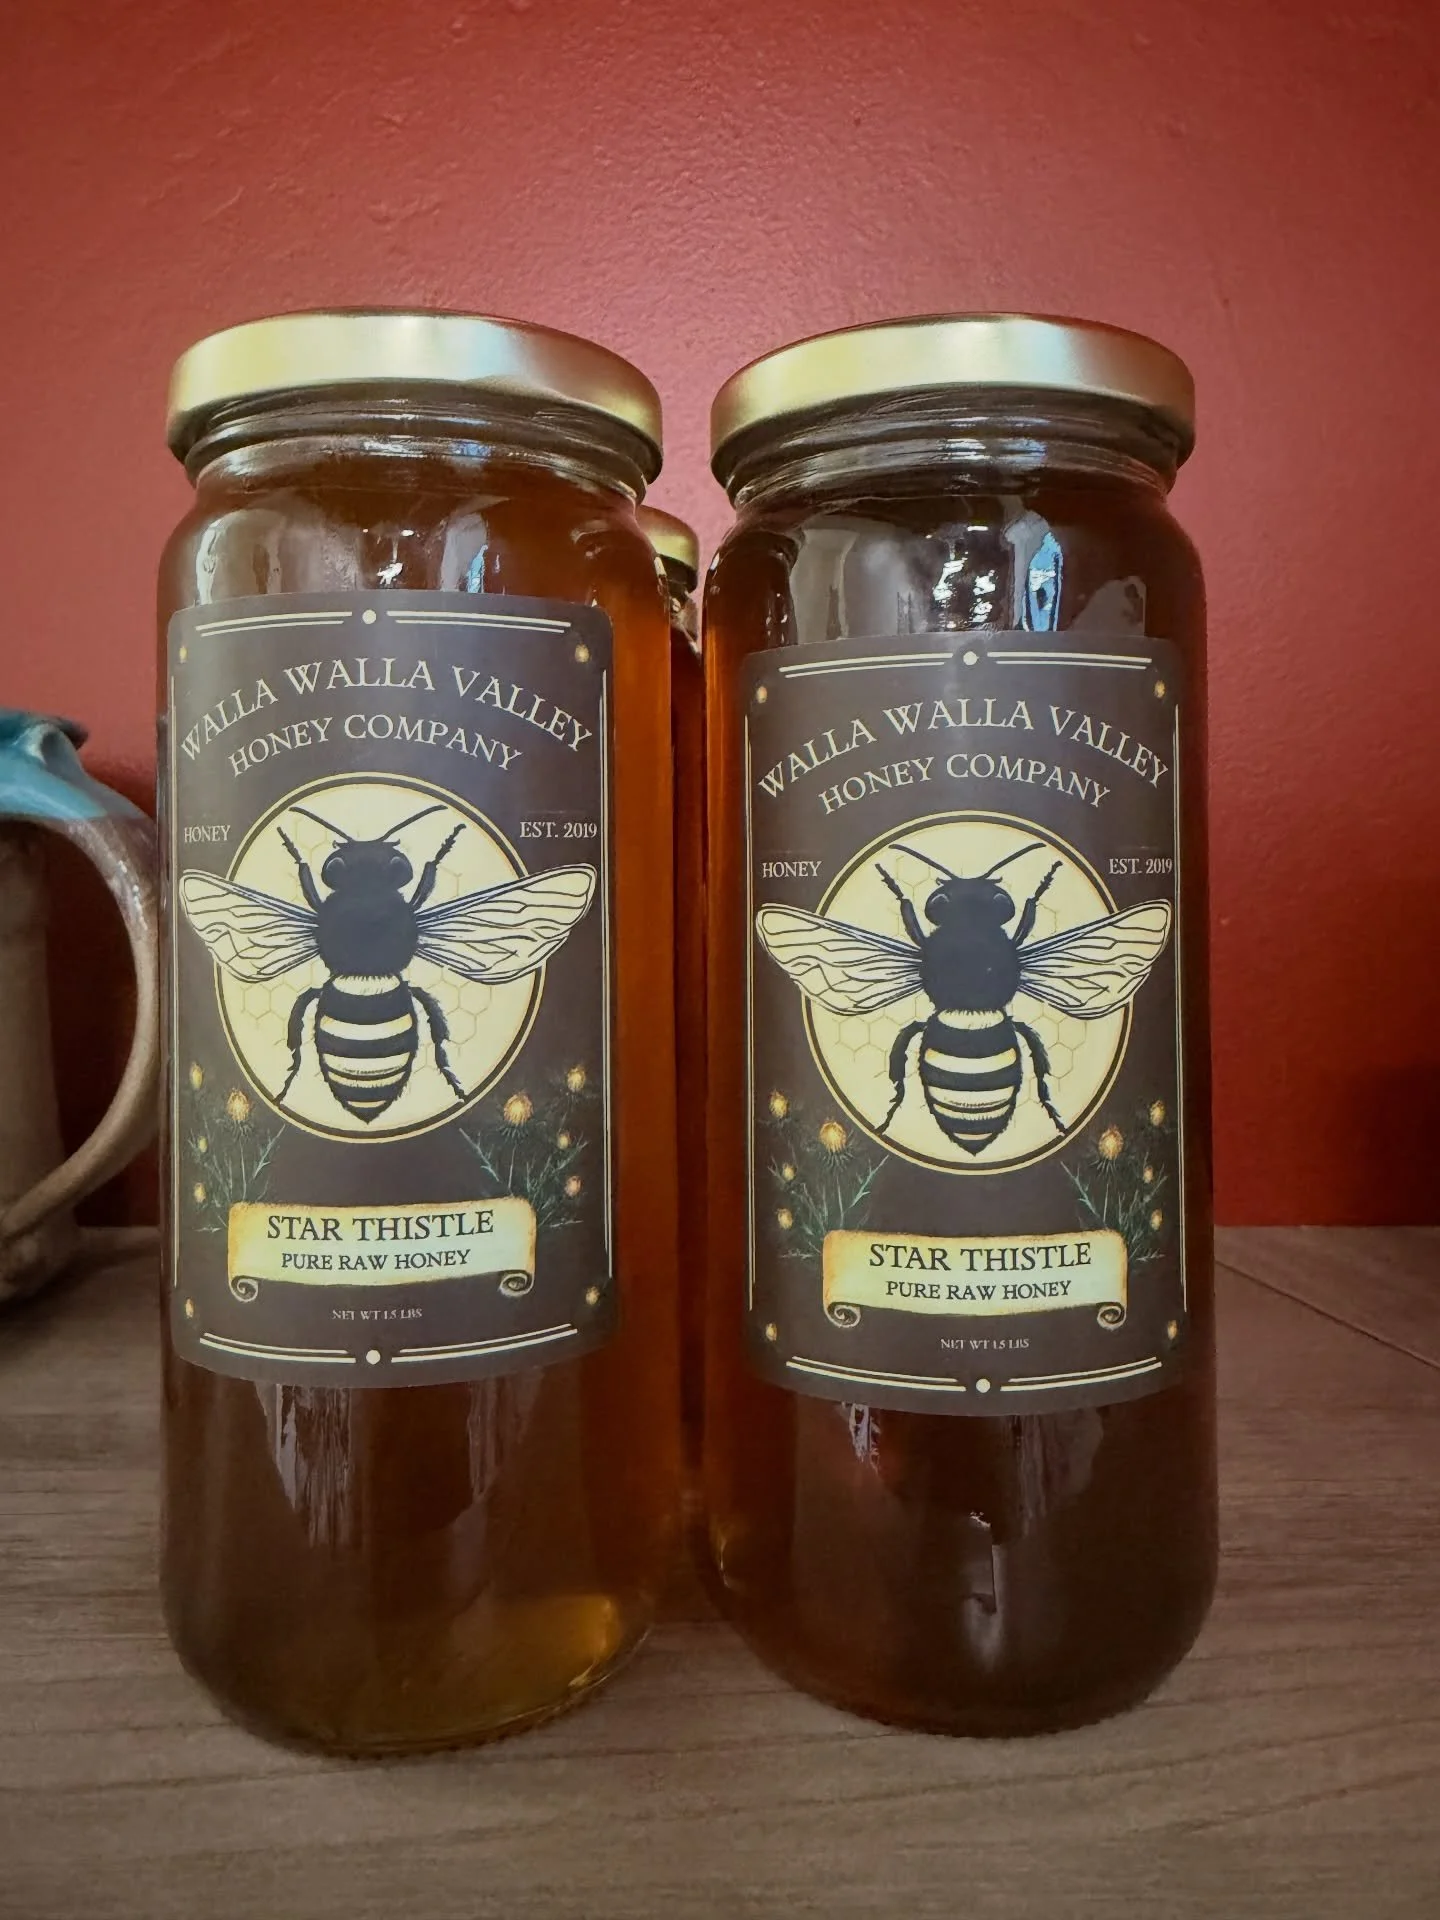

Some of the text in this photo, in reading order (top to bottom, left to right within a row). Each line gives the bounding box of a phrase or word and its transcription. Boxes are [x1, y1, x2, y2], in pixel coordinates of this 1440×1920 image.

[180, 657, 593, 761] WALLA WALLA VALLEY
[228, 713, 523, 777] HONEY COMPANY
[758, 698, 1169, 799] WALLA WALLA VALLEY
[818, 753, 1110, 815] HONEY COMPANY
[184, 825, 230, 843] HONEY
[519, 821, 598, 839] EST. 2019
[762, 860, 822, 878] HONEY
[1108, 858, 1173, 875] EST. 2019
[267, 1210, 494, 1241] STAR THISTLE
[281, 1249, 471, 1271] PURE RAW HONEY
[869, 1242, 1091, 1272] STAR THISTLE
[885, 1280, 1071, 1300] PURE RAW HONEY
[332, 1309, 355, 1320] NET
[360, 1310, 380, 1320] WT
[941, 1338, 964, 1349] NET
[969, 1339, 989, 1349] WT
